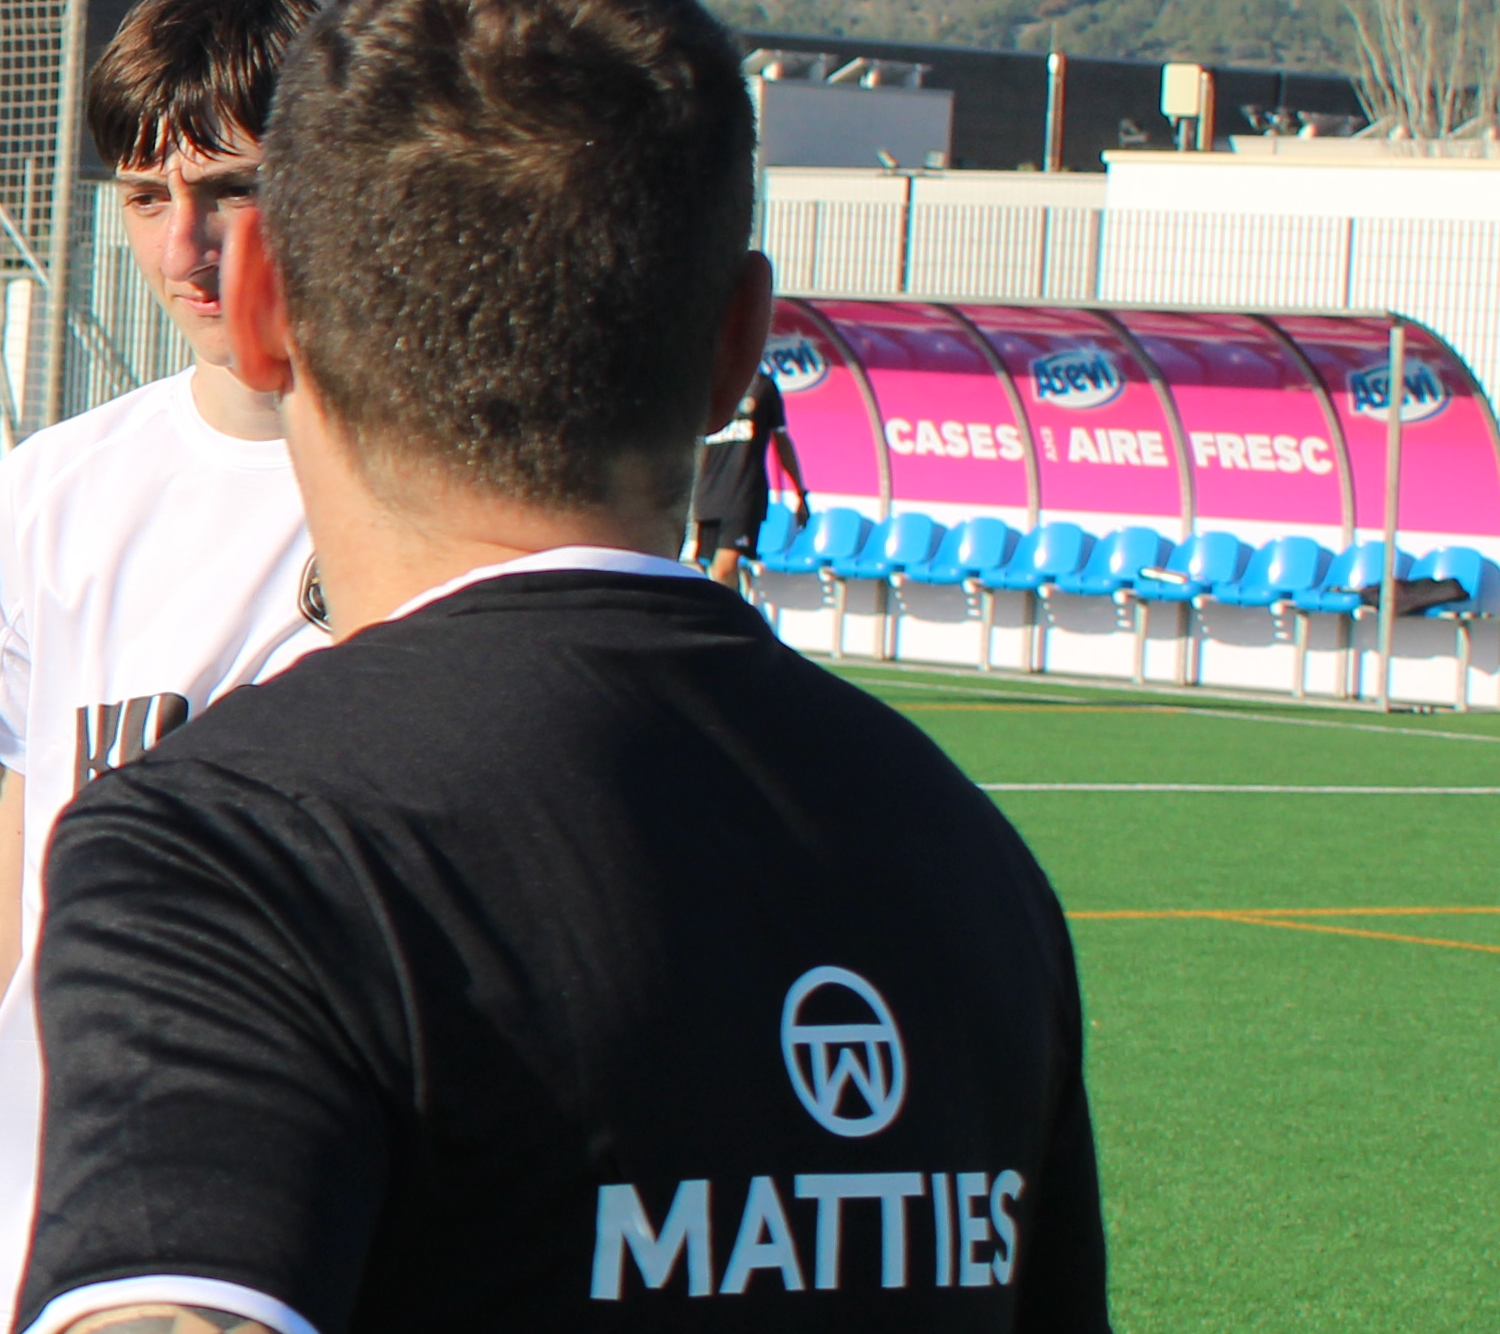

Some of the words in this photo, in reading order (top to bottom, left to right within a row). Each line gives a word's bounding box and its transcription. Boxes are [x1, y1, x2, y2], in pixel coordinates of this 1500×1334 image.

[884, 417, 1025, 462] CASES
[1067, 426, 1169, 467] AIRE
[1188, 431, 1334, 475] FRESC
[590, 1169, 1026, 1301] MATTIES
